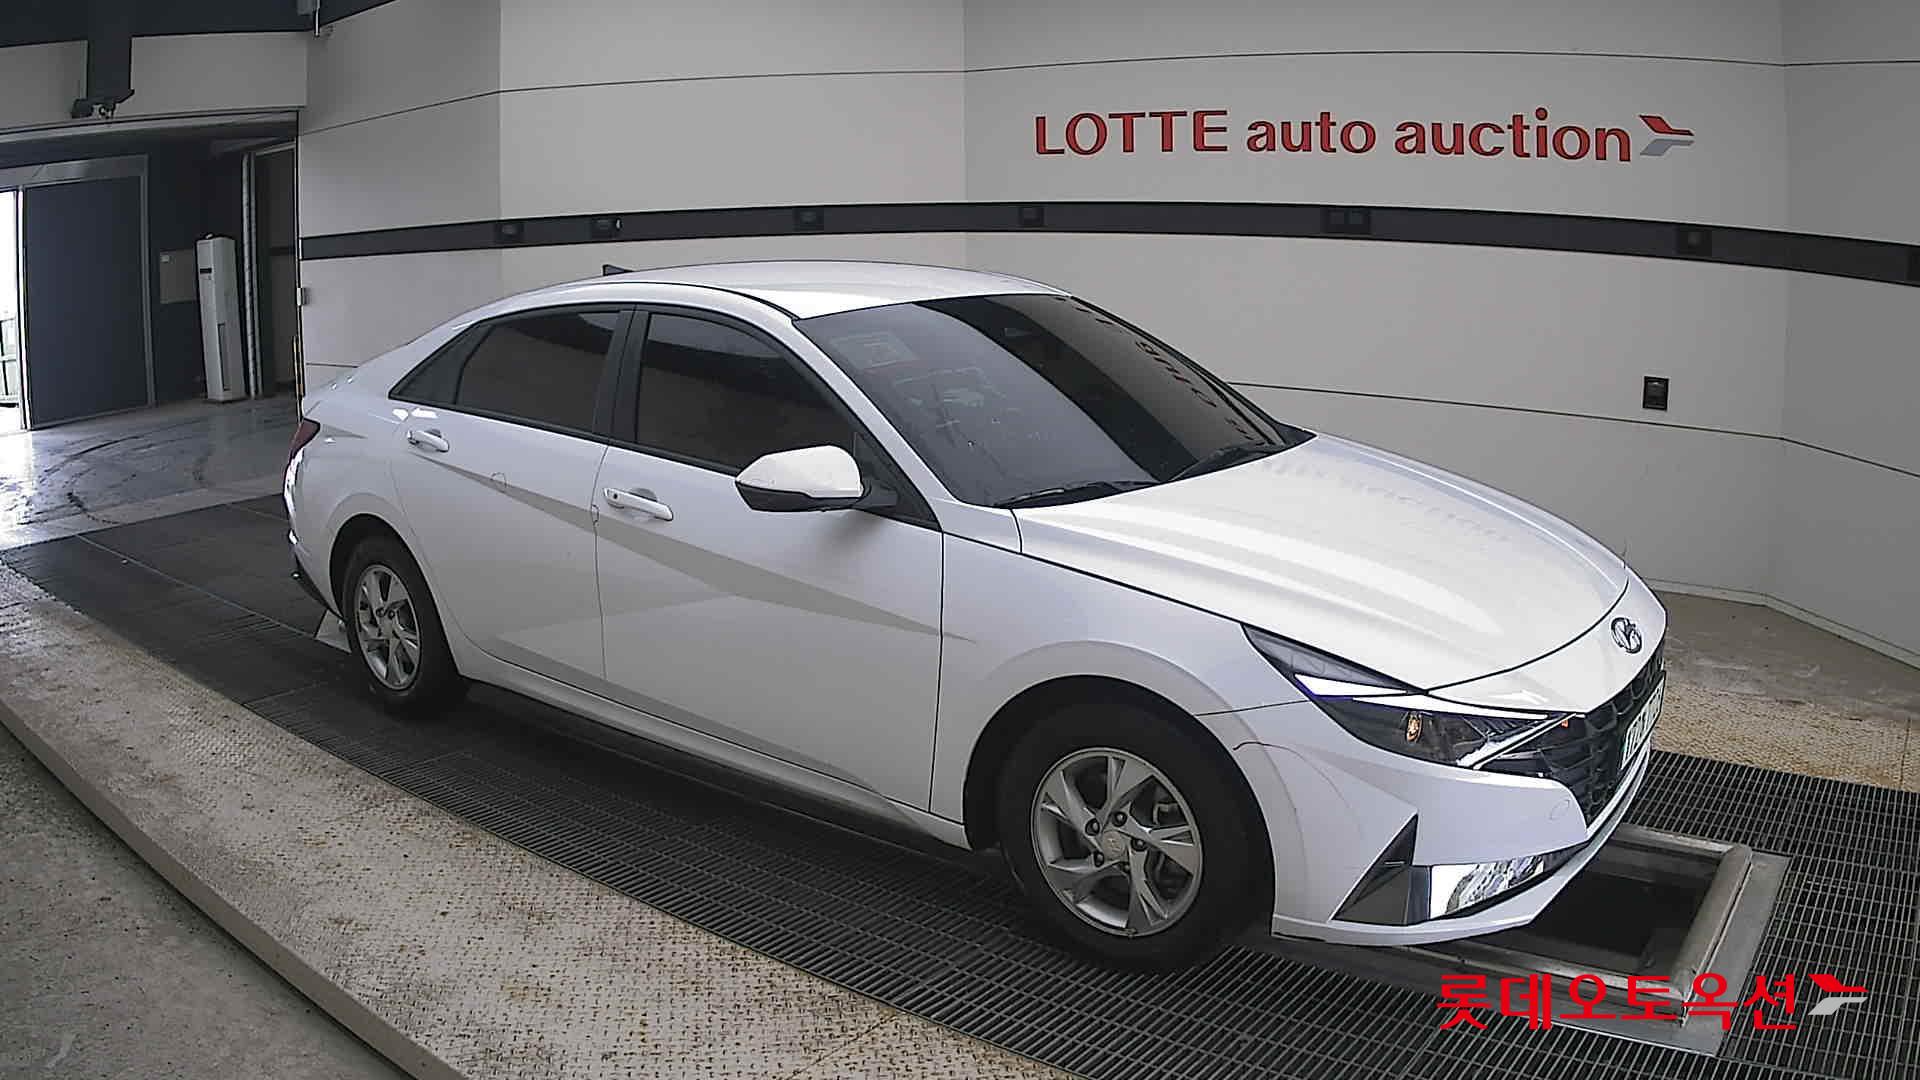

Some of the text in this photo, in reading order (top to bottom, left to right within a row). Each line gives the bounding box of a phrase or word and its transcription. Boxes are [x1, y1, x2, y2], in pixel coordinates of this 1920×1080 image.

[1035, 108, 1631, 162] LOTTE auto auction
